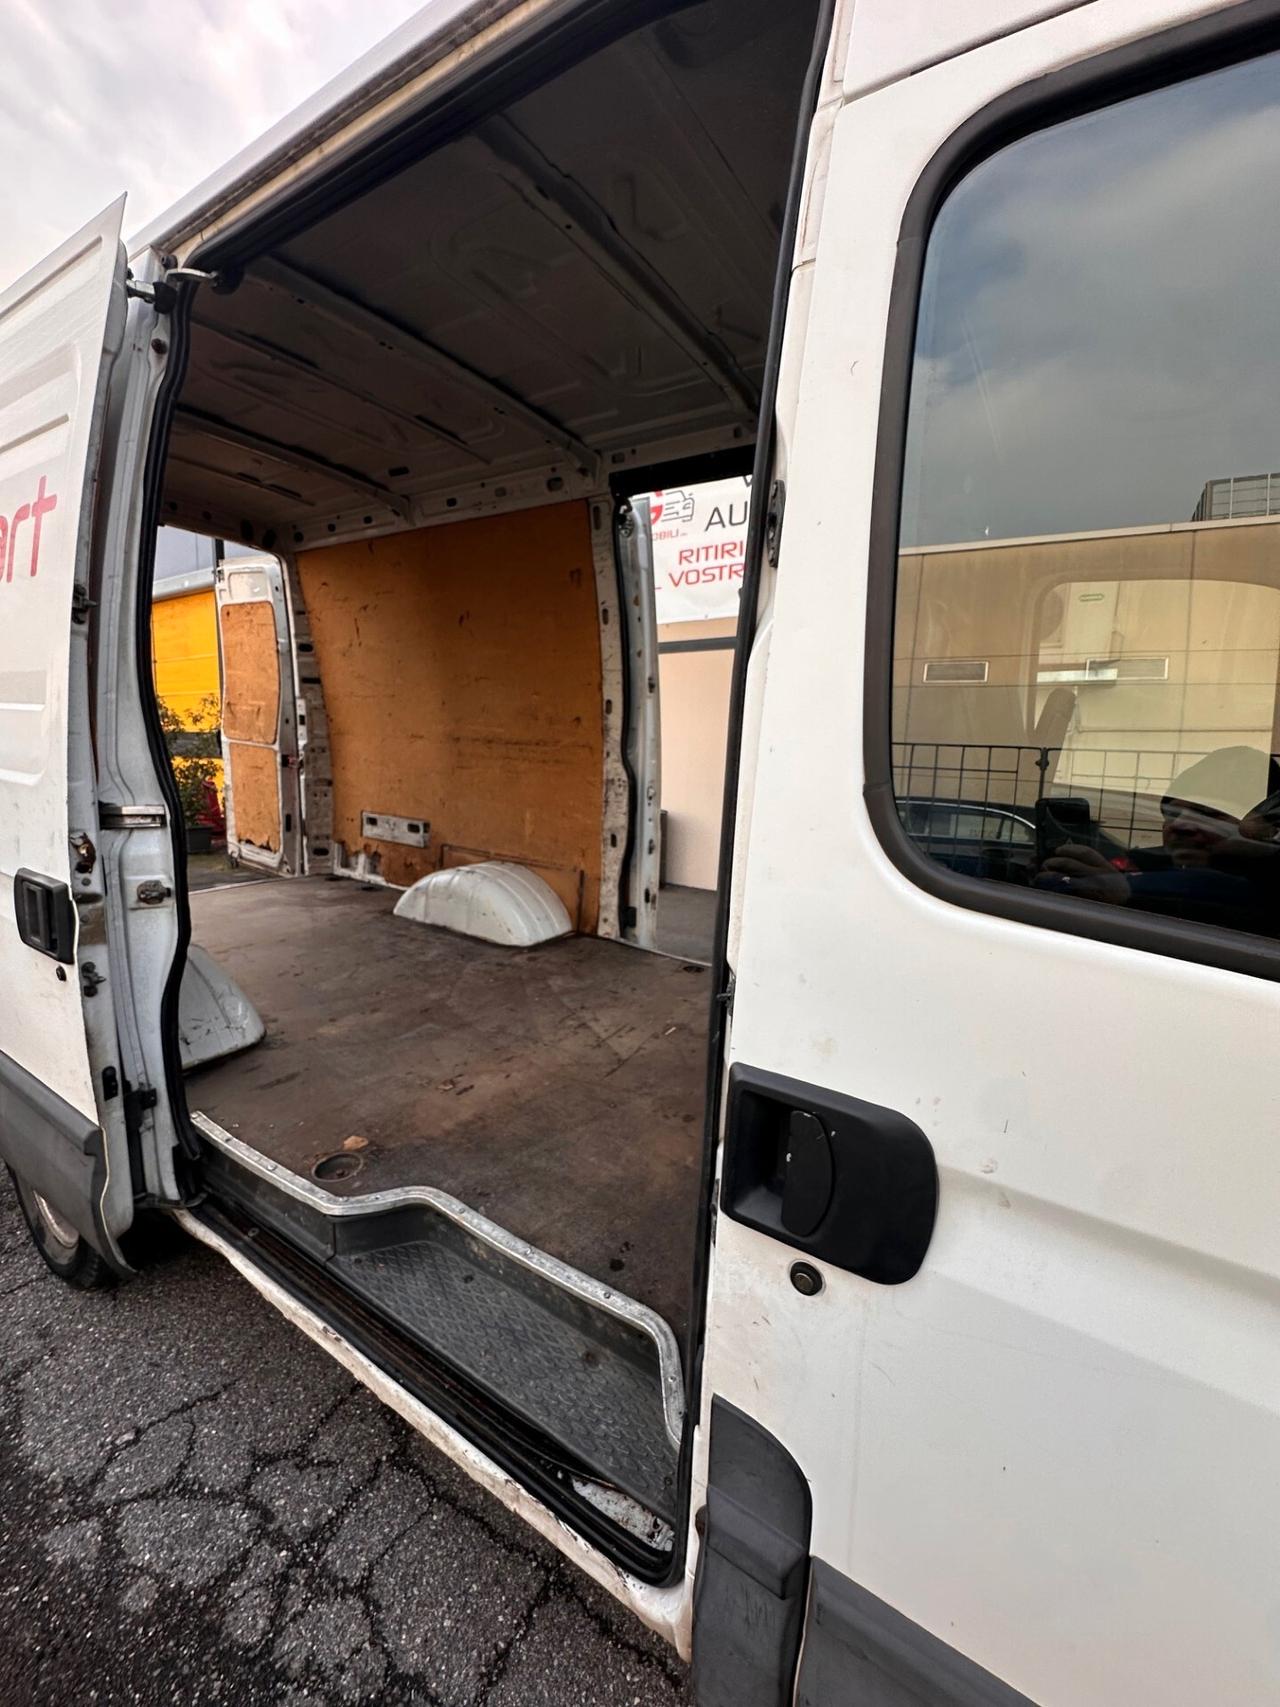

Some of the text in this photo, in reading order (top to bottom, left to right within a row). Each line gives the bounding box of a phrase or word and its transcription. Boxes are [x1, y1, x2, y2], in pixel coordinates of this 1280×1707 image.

[704, 501, 748, 532] AU
[679, 541, 743, 566] RITIRI
[669, 563, 745, 588] VOSTR
